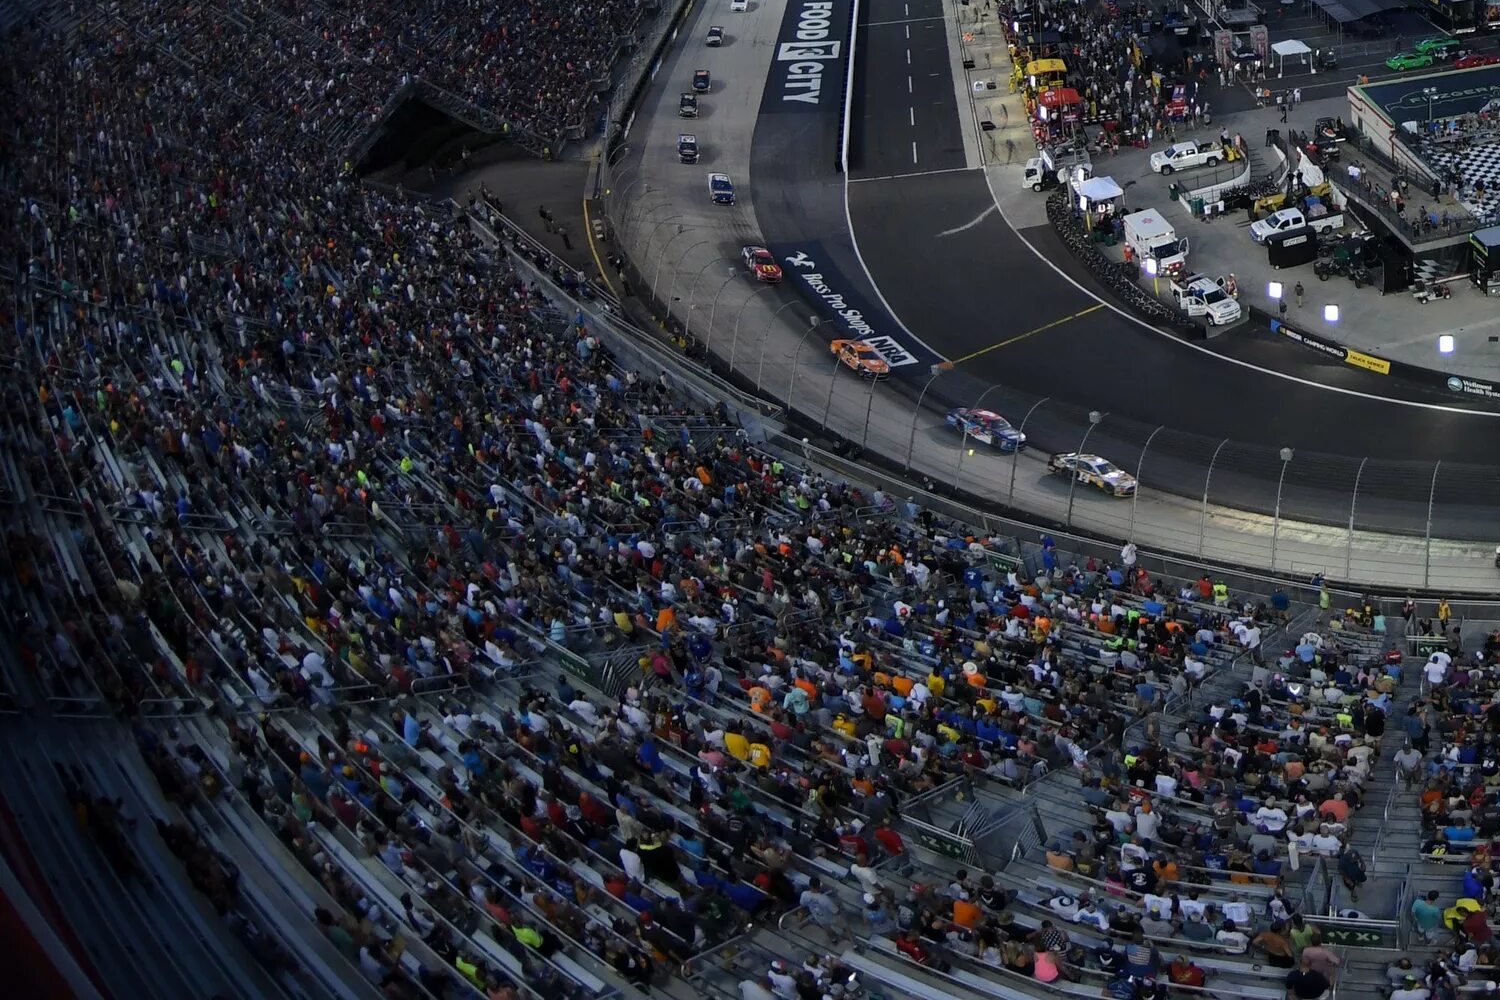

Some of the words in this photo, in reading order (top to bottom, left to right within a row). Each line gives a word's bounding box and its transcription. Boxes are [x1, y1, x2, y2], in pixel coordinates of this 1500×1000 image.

[796, 1, 833, 40] FOOD
[783, 61, 825, 105] CITY
[801, 273, 832, 299] Bass
[827, 293, 847, 310] Pro
[838, 309, 877, 337] Shops
[870, 337, 911, 366] NRA
[1304, 337, 1326, 351] CAMPING
[1325, 344, 1345, 358] WORLD
[1350, 354, 1366, 364] TRUCK
[1367, 359, 1386, 370] SERIES
[1463, 379, 1493, 391] Wellmont
[1463, 386, 1485, 396] Health
[1336, 931, 1350, 940] Y
[1355, 932, 1371, 941] X
